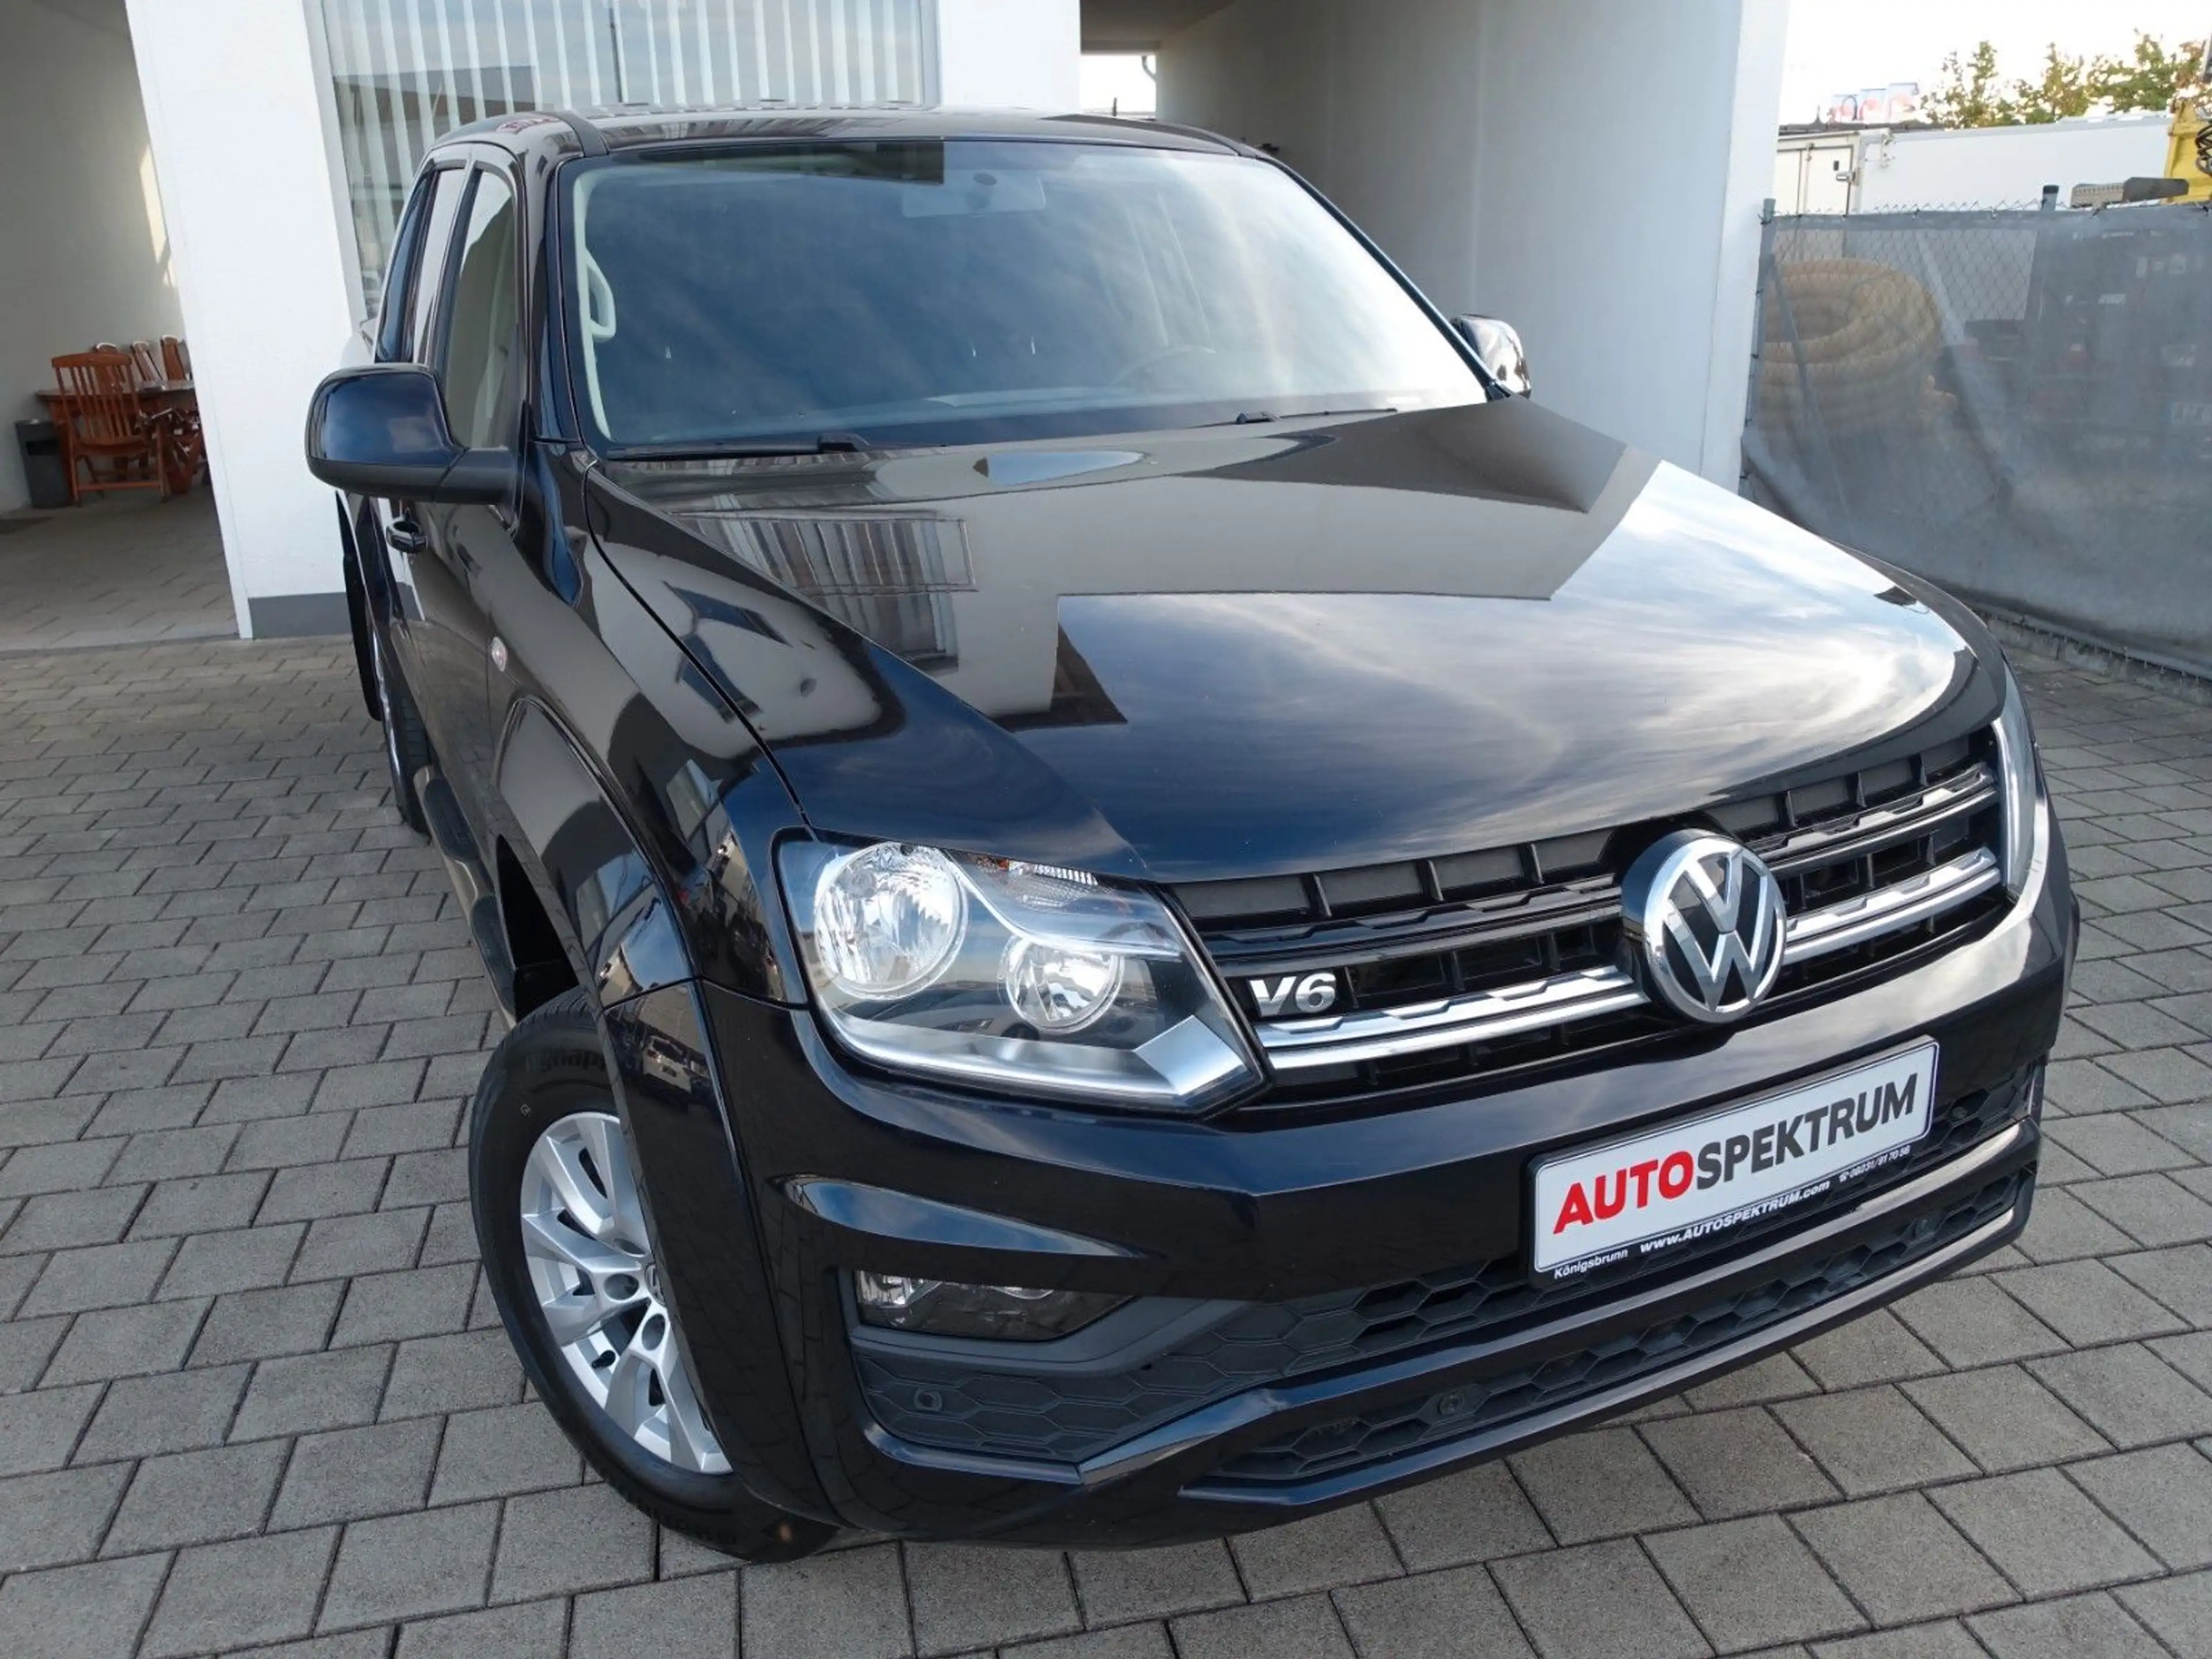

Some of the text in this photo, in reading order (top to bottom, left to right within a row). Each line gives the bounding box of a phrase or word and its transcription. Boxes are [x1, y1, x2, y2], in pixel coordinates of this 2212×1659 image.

[1249, 972, 1336, 1017] V6
[1553, 1073, 1918, 1234] AUTOSPEKTRUM
[1554, 1249, 1628, 1279] Königsbrunn
[1640, 1180, 1830, 1253] www.AUTOSPEKTRUM.com
